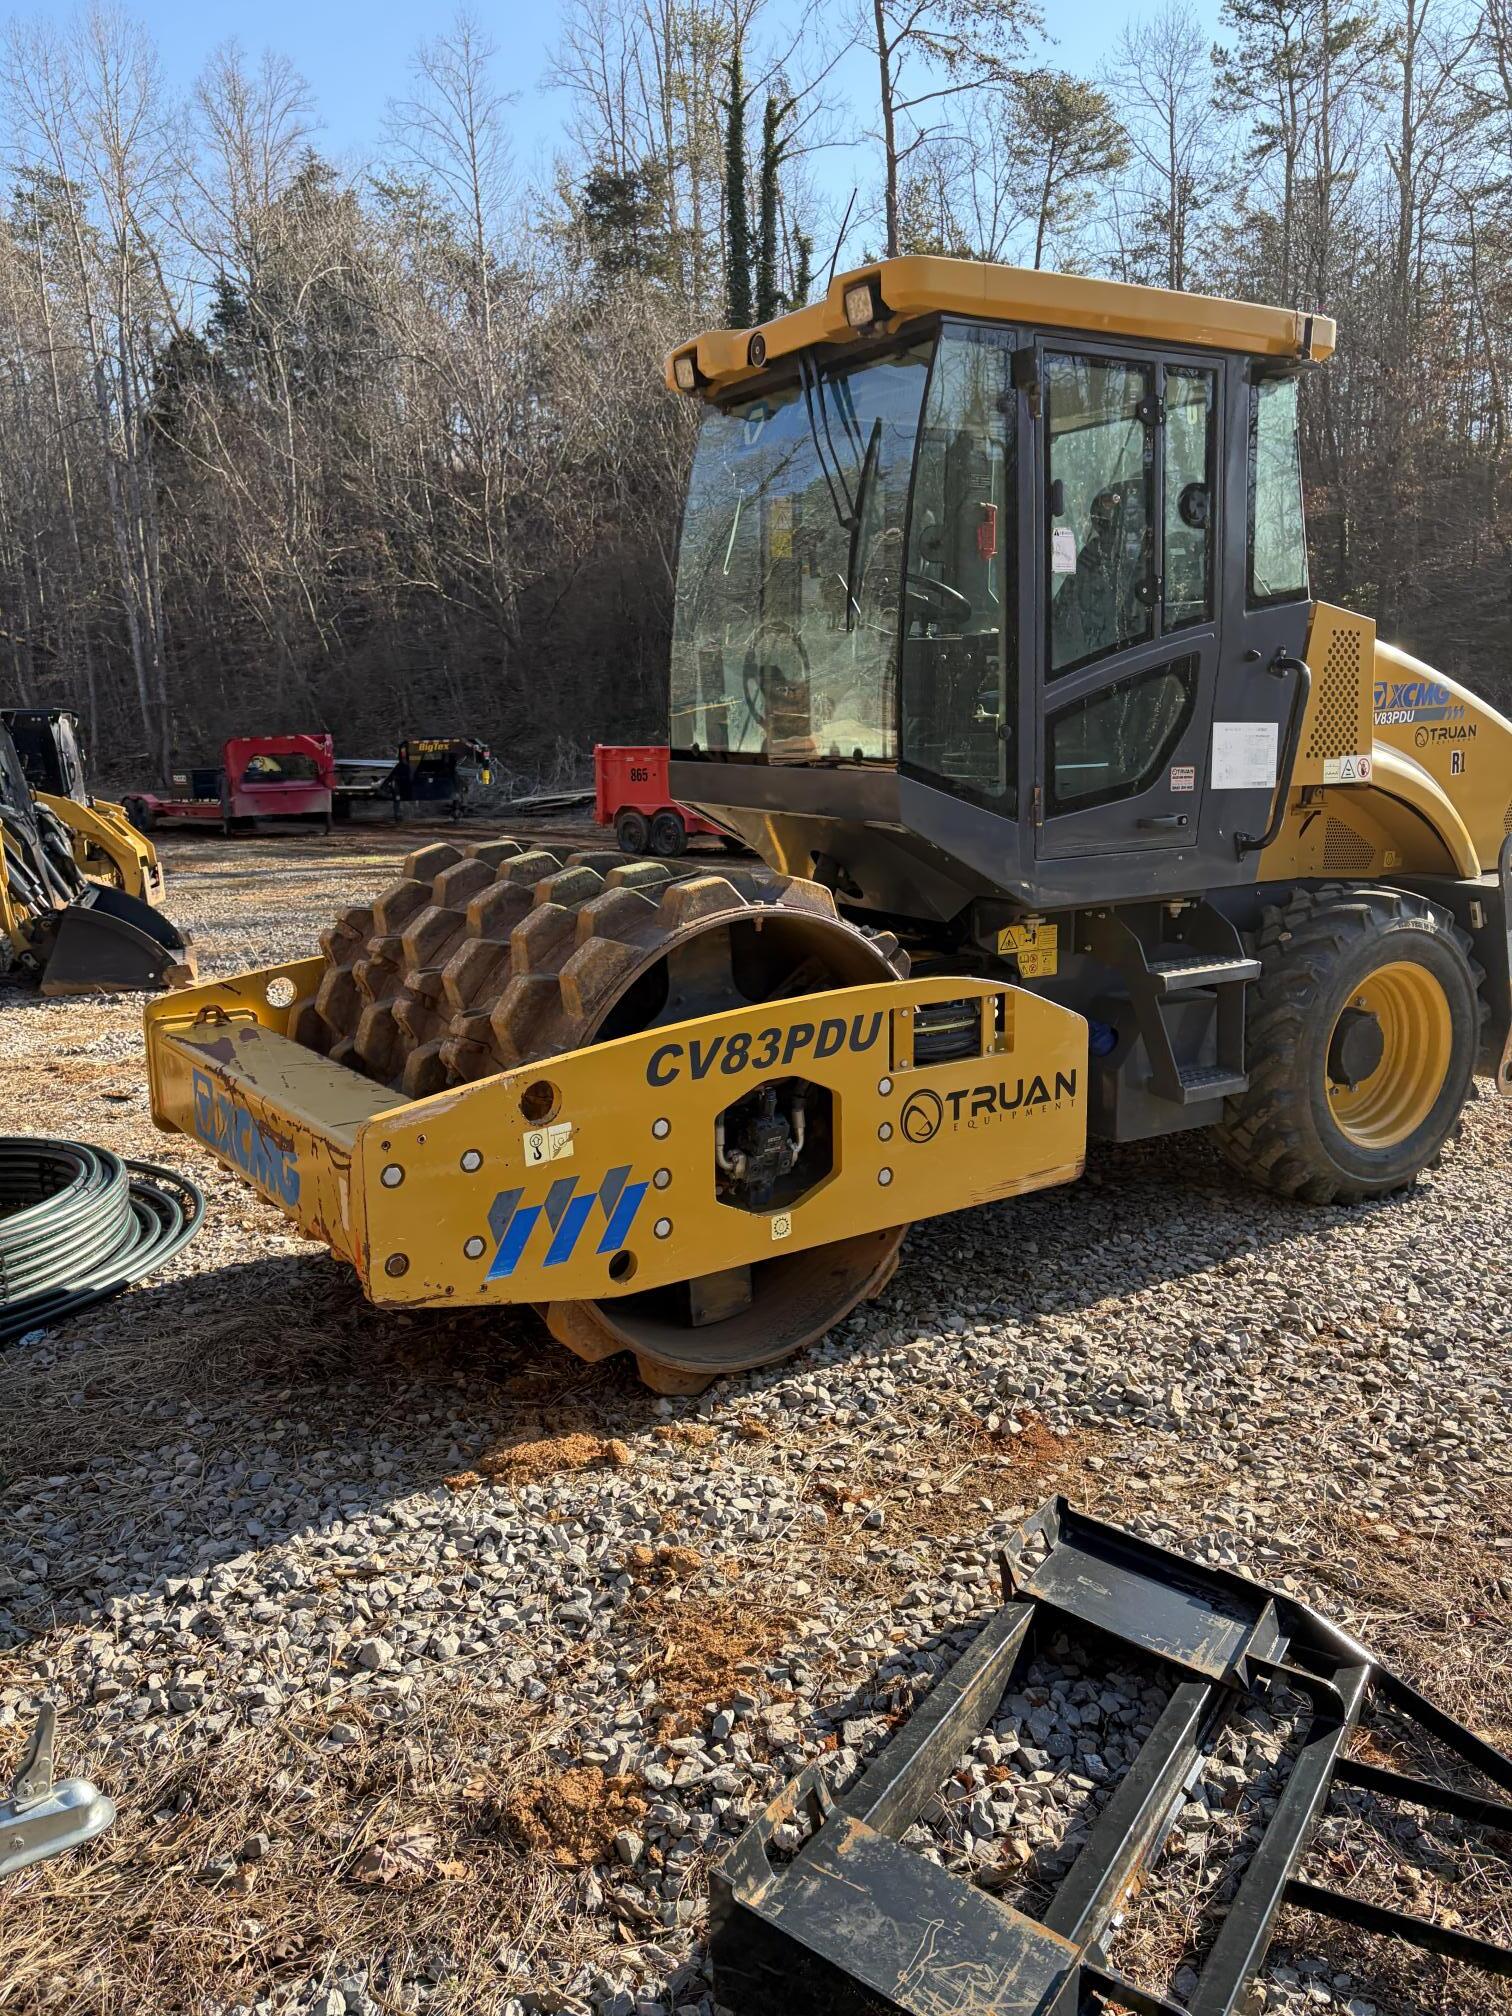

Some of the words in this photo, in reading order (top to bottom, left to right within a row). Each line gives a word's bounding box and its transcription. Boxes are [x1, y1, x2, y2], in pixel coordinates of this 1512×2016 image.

[1374, 710, 1415, 725] V83PDU
[1430, 725, 1477, 741] TRUAN
[1451, 751, 1466, 774] R1
[630, 767, 649, 782] 865
[646, 1011, 884, 1087] CV83PDU
[945, 1069, 1077, 1121] TRUAN
[953, 1099, 1076, 1132] EQUIPMENT
